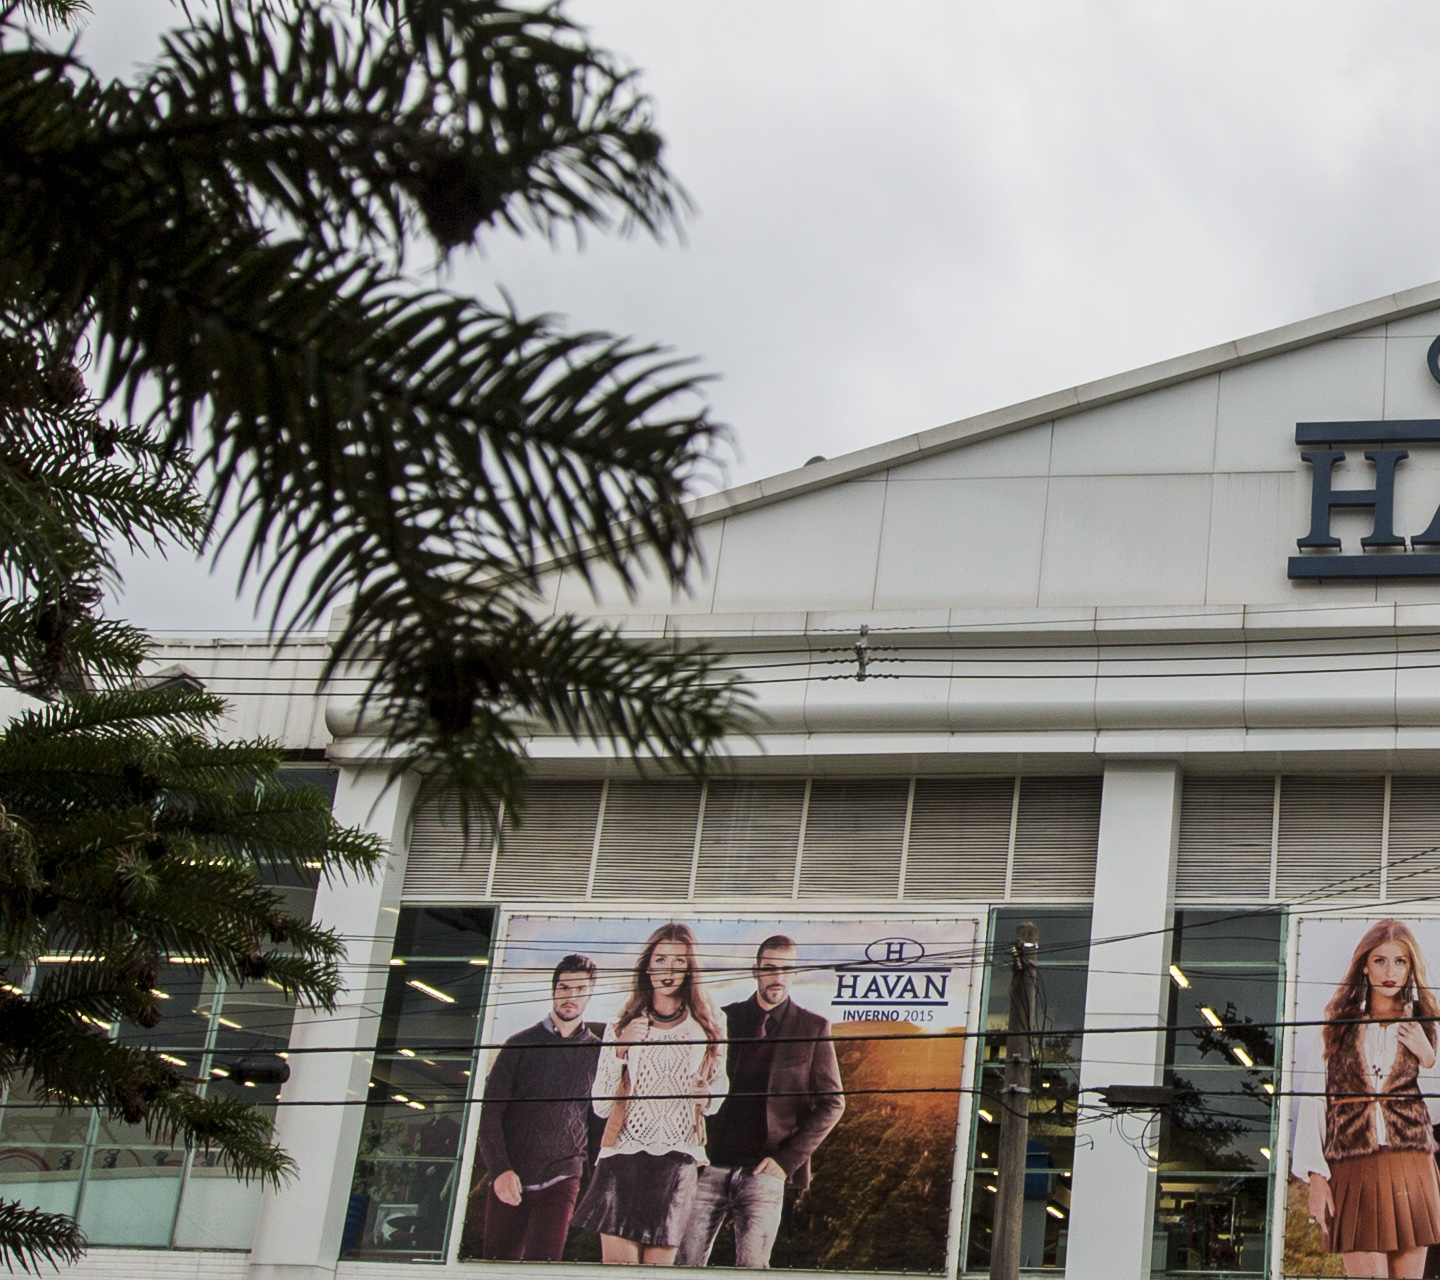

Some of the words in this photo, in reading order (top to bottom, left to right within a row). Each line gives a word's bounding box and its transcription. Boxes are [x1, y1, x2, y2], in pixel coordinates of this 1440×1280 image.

[885, 942, 906, 962] H
[834, 975, 949, 999] HAVAN
[842, 1009, 900, 1021] INVERNO
[903, 1010, 934, 1021] 2015
